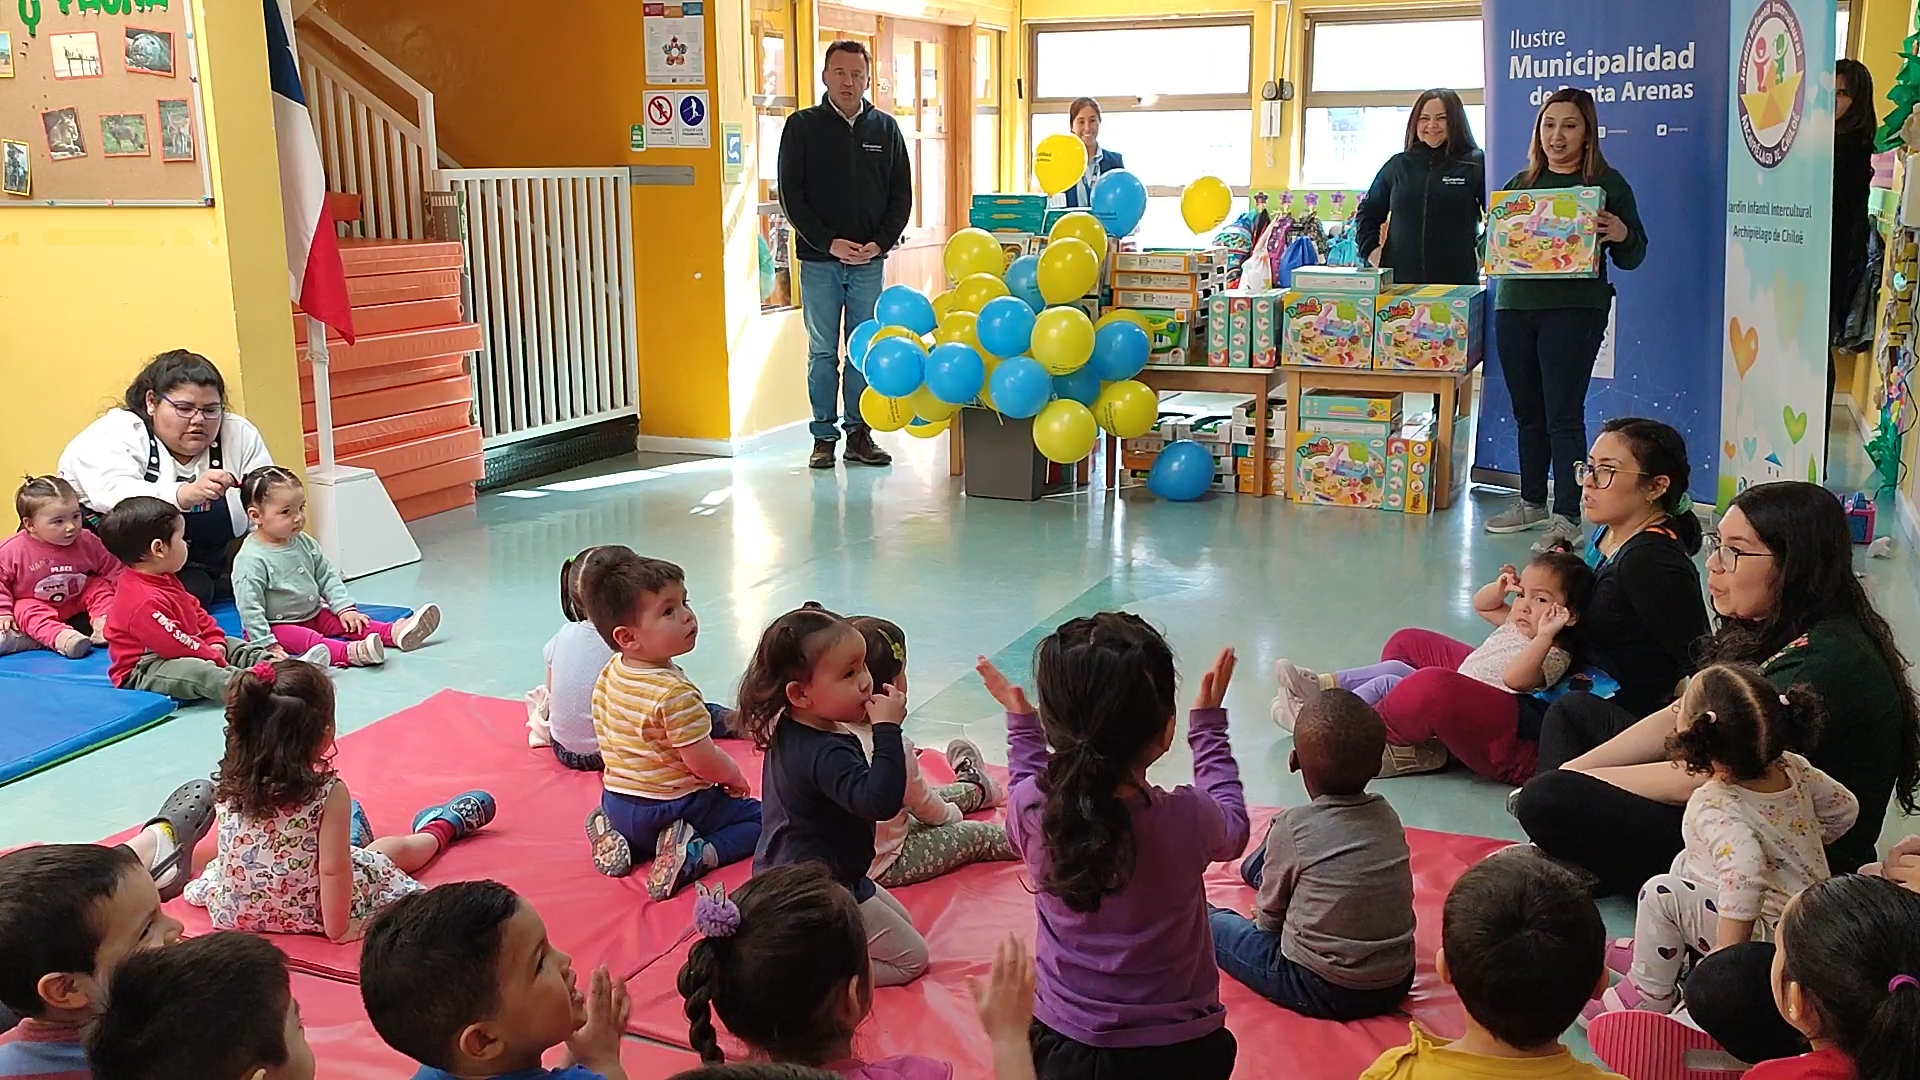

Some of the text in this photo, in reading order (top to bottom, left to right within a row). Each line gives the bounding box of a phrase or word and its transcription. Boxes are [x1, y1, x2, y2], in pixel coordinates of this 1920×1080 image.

[1510, 29, 1566, 49] Ilustre
[1509, 41, 1696, 81] Municipalidad
[1529, 86, 1552, 106] de
[1620, 81, 1694, 102] Arenas
[1748, 201, 1770, 215] Infantil
[1772, 203, 1812, 218] Intercultural
[1773, 228, 1781, 242] de
